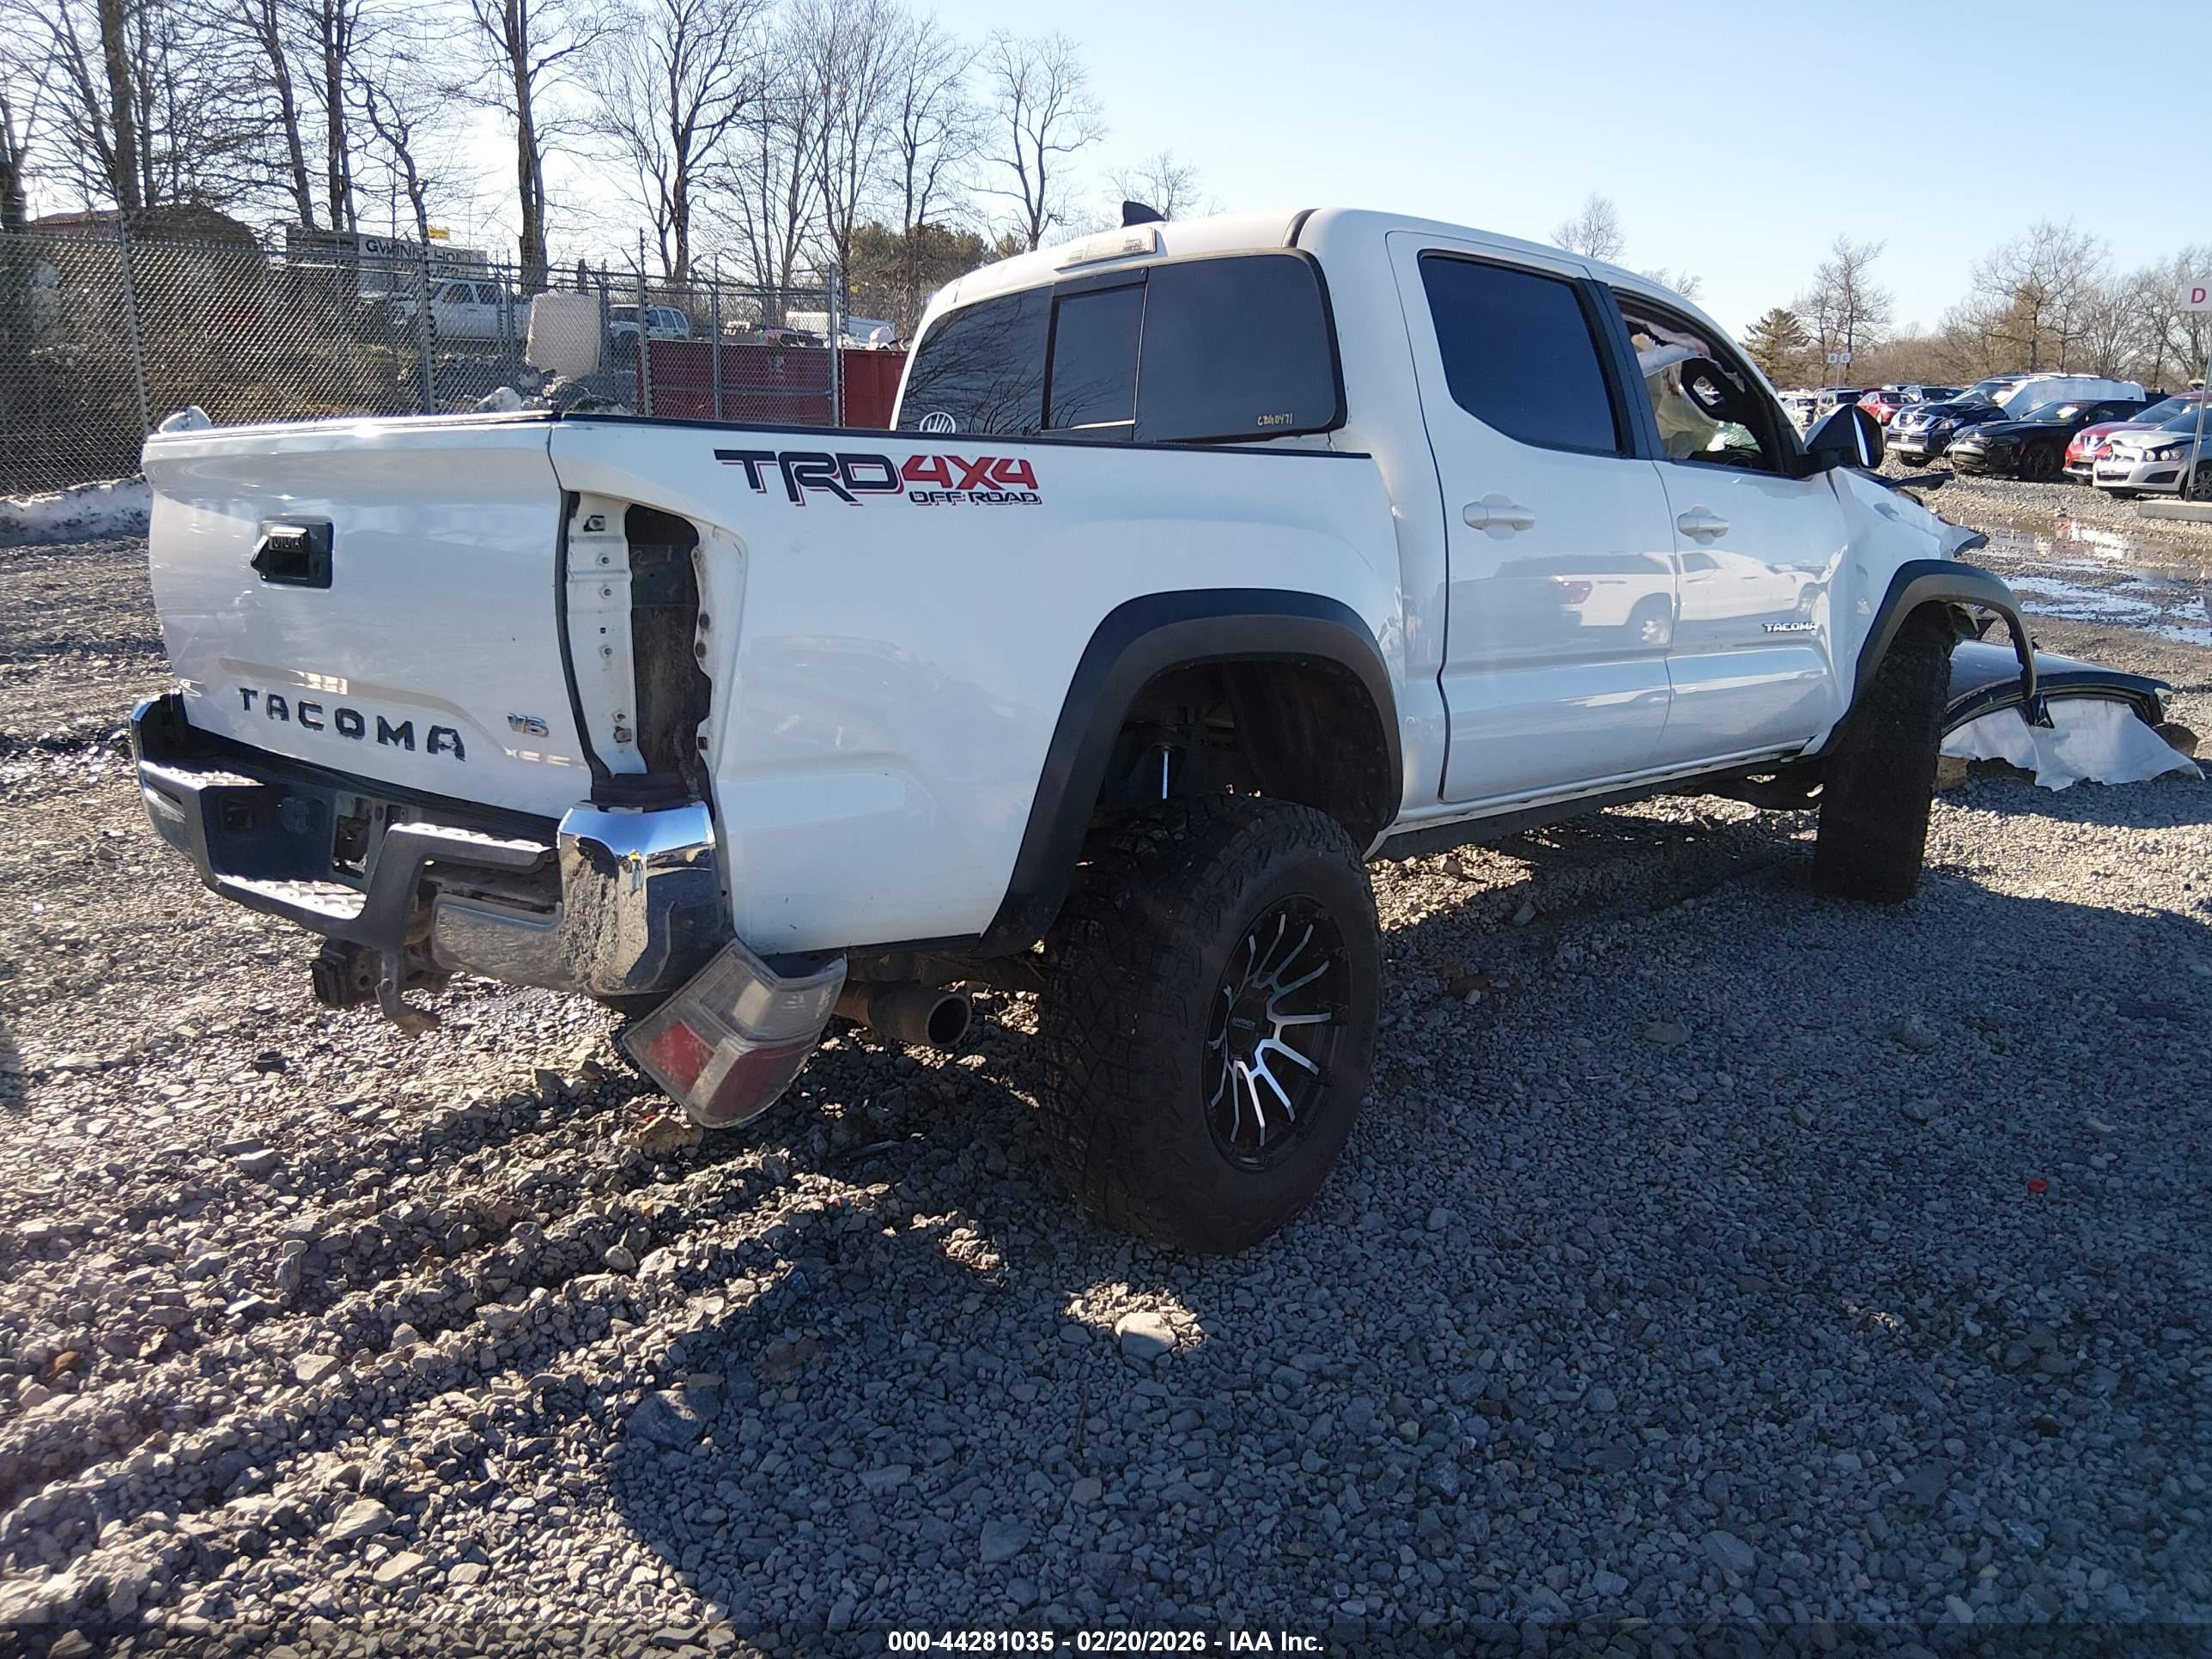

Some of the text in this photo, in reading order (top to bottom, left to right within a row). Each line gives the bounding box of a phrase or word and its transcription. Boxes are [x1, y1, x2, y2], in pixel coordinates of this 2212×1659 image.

[2191, 288, 2207, 304] D
[714, 448, 1039, 507] TRD 4X4
[909, 491, 1042, 506] OFF ROAD
[1765, 622, 1818, 633] TACOMA
[239, 687, 466, 763] TACOMA
[507, 713, 550, 738] V6
